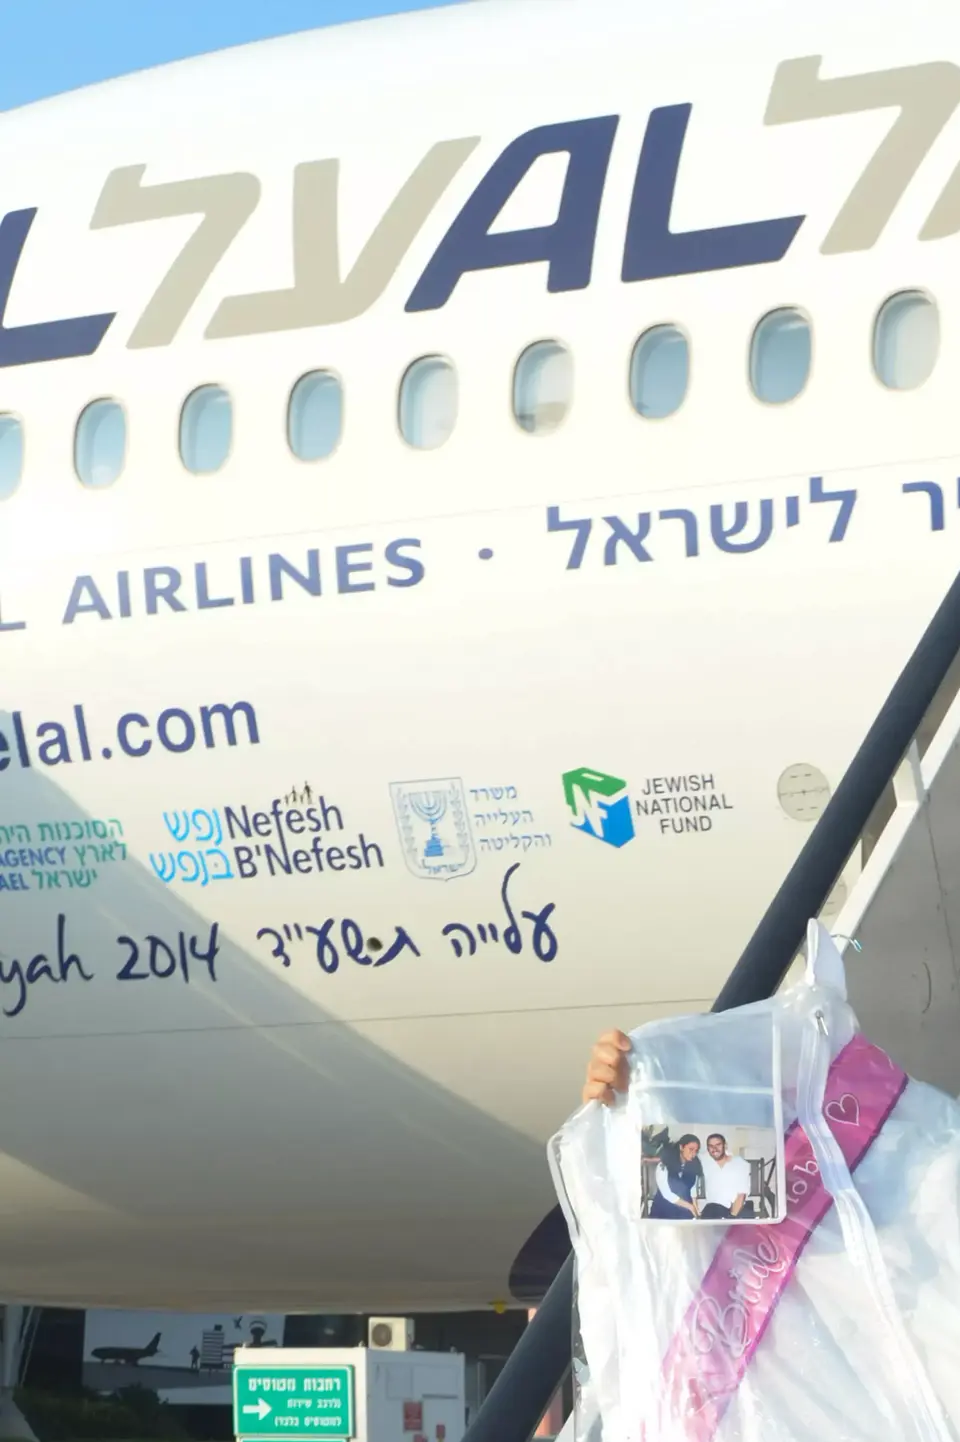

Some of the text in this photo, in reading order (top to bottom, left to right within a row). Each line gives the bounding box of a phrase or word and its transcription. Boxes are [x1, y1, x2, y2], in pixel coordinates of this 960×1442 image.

[547, 476, 857, 570] לישראל
[62, 538, 426, 625] AIRLINES
[0, 701, 260, 771] lal.com
[470, 785, 517, 802] משרד
[641, 774, 715, 796] JEWISH
[635, 793, 734, 816] NATIONAL
[37, 818, 123, 842] הסוכנות
[162, 808, 223, 846] נפש
[224, 795, 344, 840] Nefesh
[474, 809, 534, 828] העלייה
[660, 816, 713, 834] FUND
[73, 841, 127, 866] לארץ
[479, 832, 552, 852] והקליטה
[233, 833, 384, 879] B'Nefesh
[31, 868, 98, 890] ישראל
[442, 862, 558, 962] עלייה
[116, 922, 220, 984] 2014
